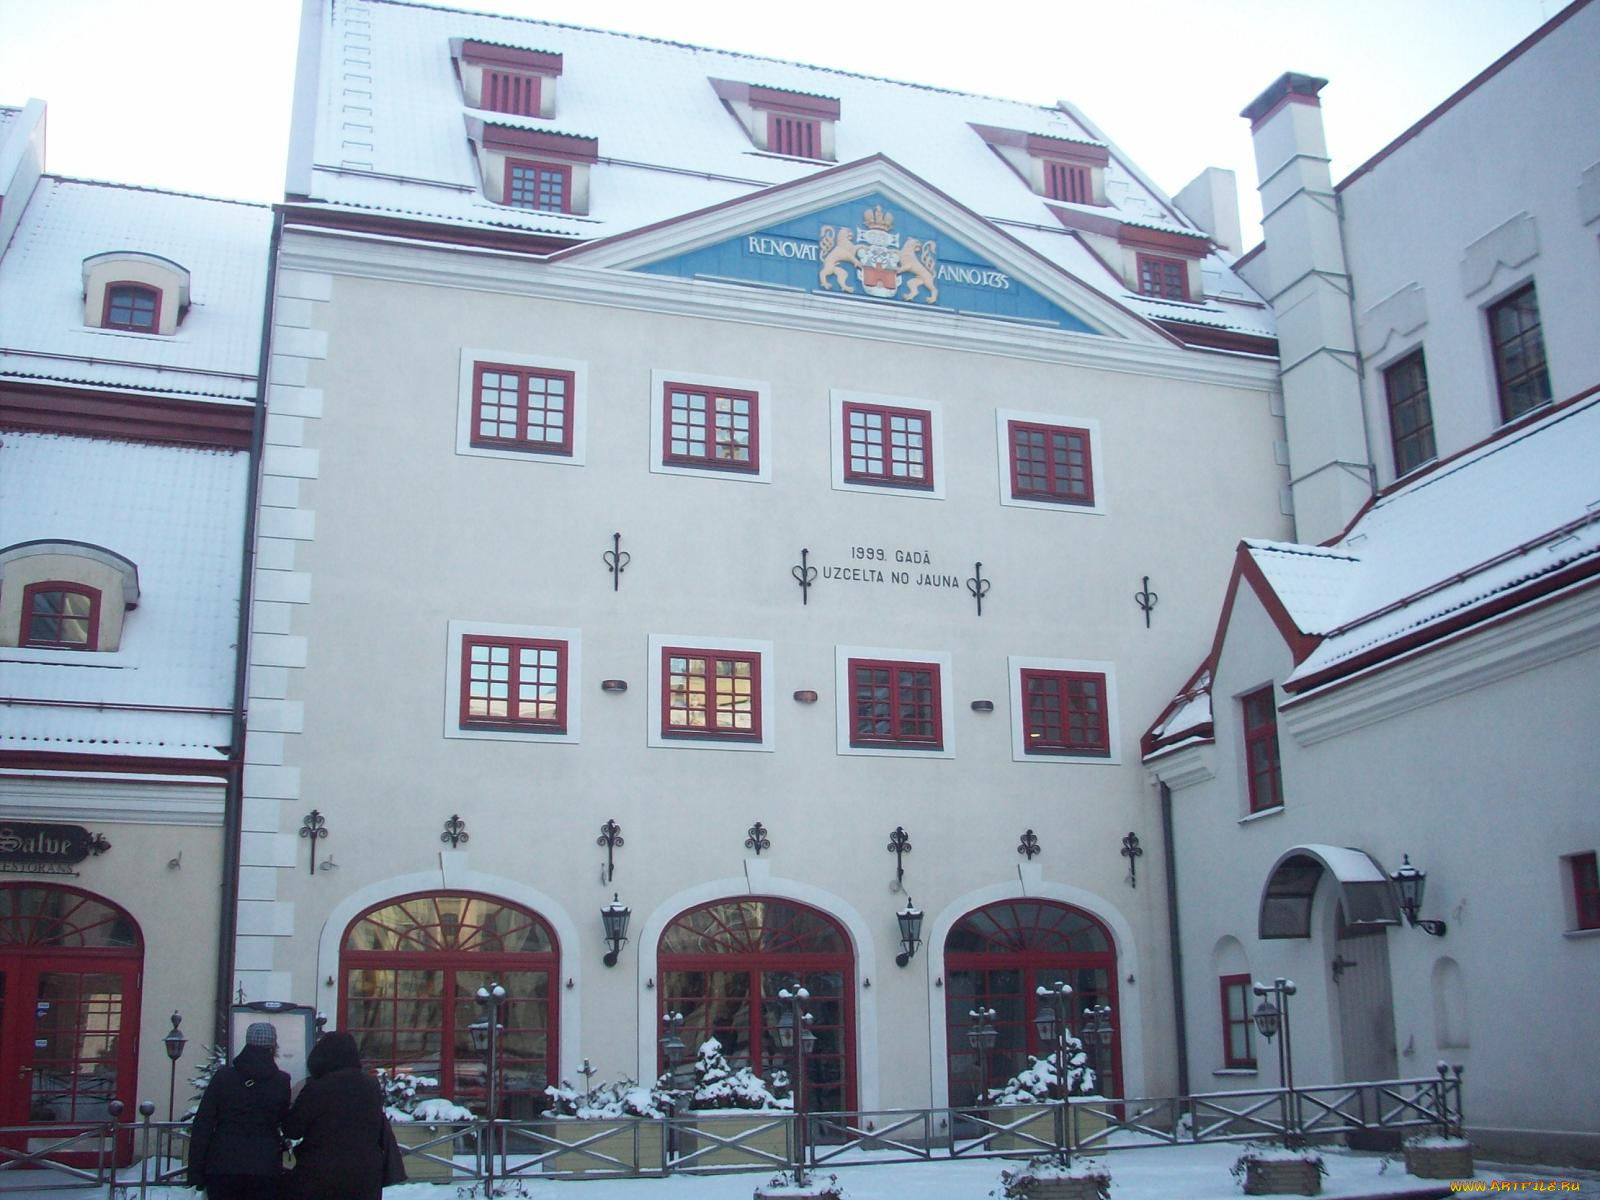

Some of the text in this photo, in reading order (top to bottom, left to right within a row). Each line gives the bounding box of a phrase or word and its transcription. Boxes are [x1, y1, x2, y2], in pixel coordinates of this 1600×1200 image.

[749, 236, 819, 261] RENOVAT
[851, 546, 931, 564] 1999. GADĀ
[823, 566, 960, 588] UZCELTA NO JAUNA
[0, 862, 73, 873] ESTORANS
